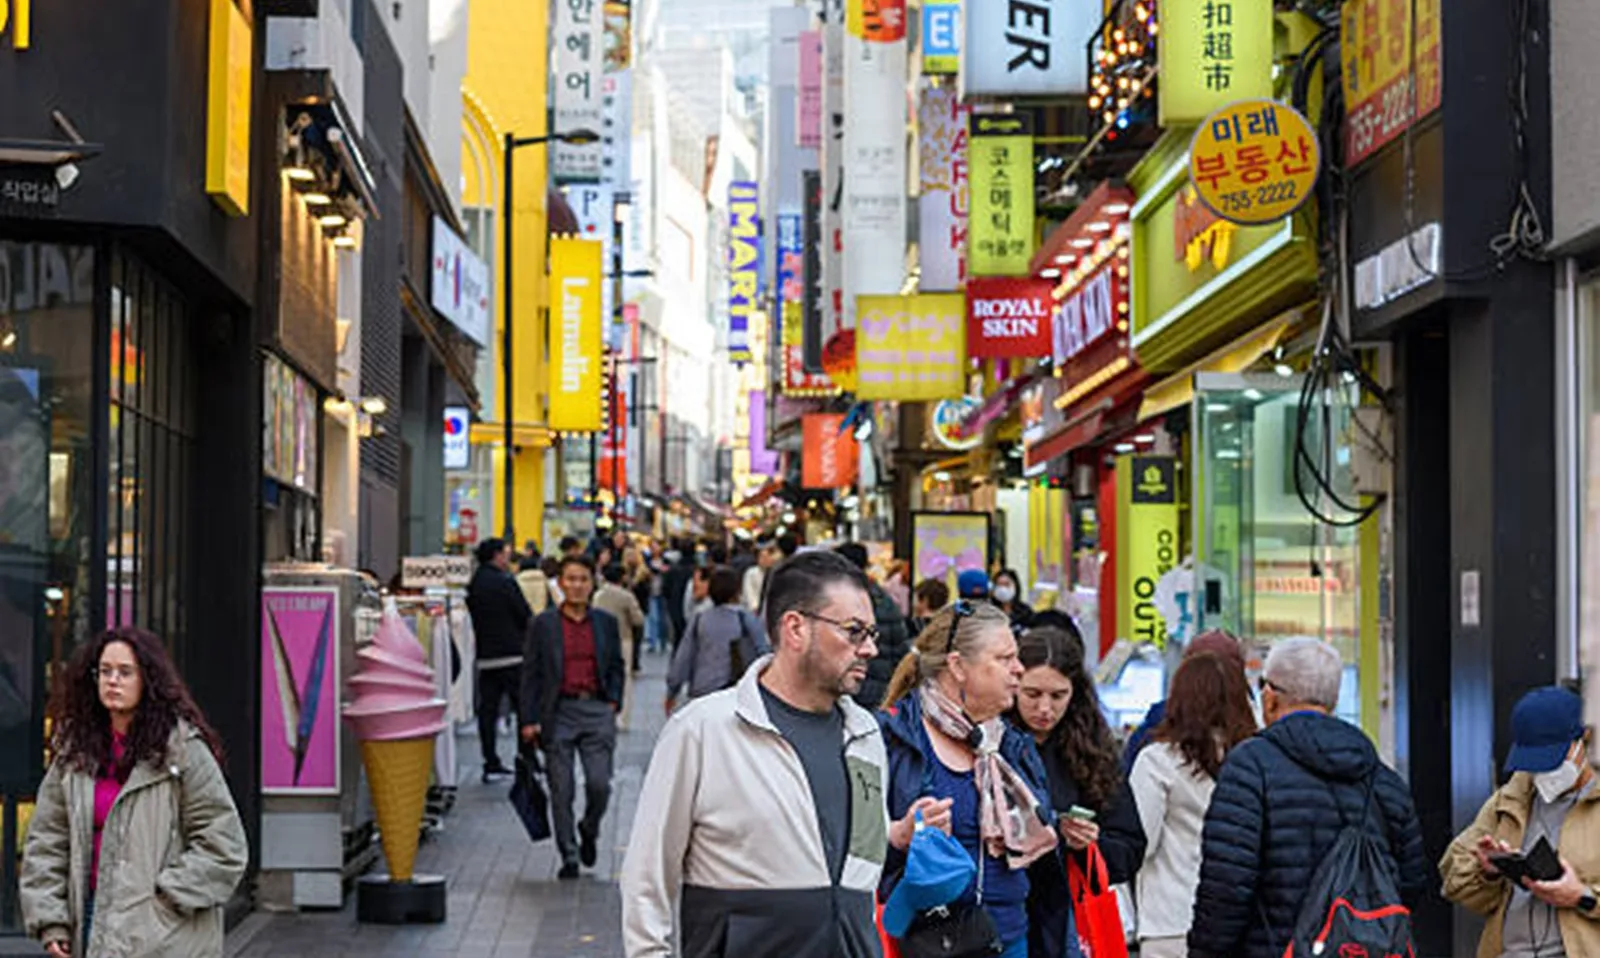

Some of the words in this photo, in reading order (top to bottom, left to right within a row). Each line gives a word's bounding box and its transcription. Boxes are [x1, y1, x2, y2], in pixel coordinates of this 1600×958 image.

[1212, 105, 1279, 143] 미래
[1196, 136, 1312, 190] 부동산
[989, 146, 1012, 233] 코스메틱
[1218, 180, 1297, 211] 755-2222
[974, 298, 1048, 317] ROYAL
[982, 319, 1038, 337] SKIN
